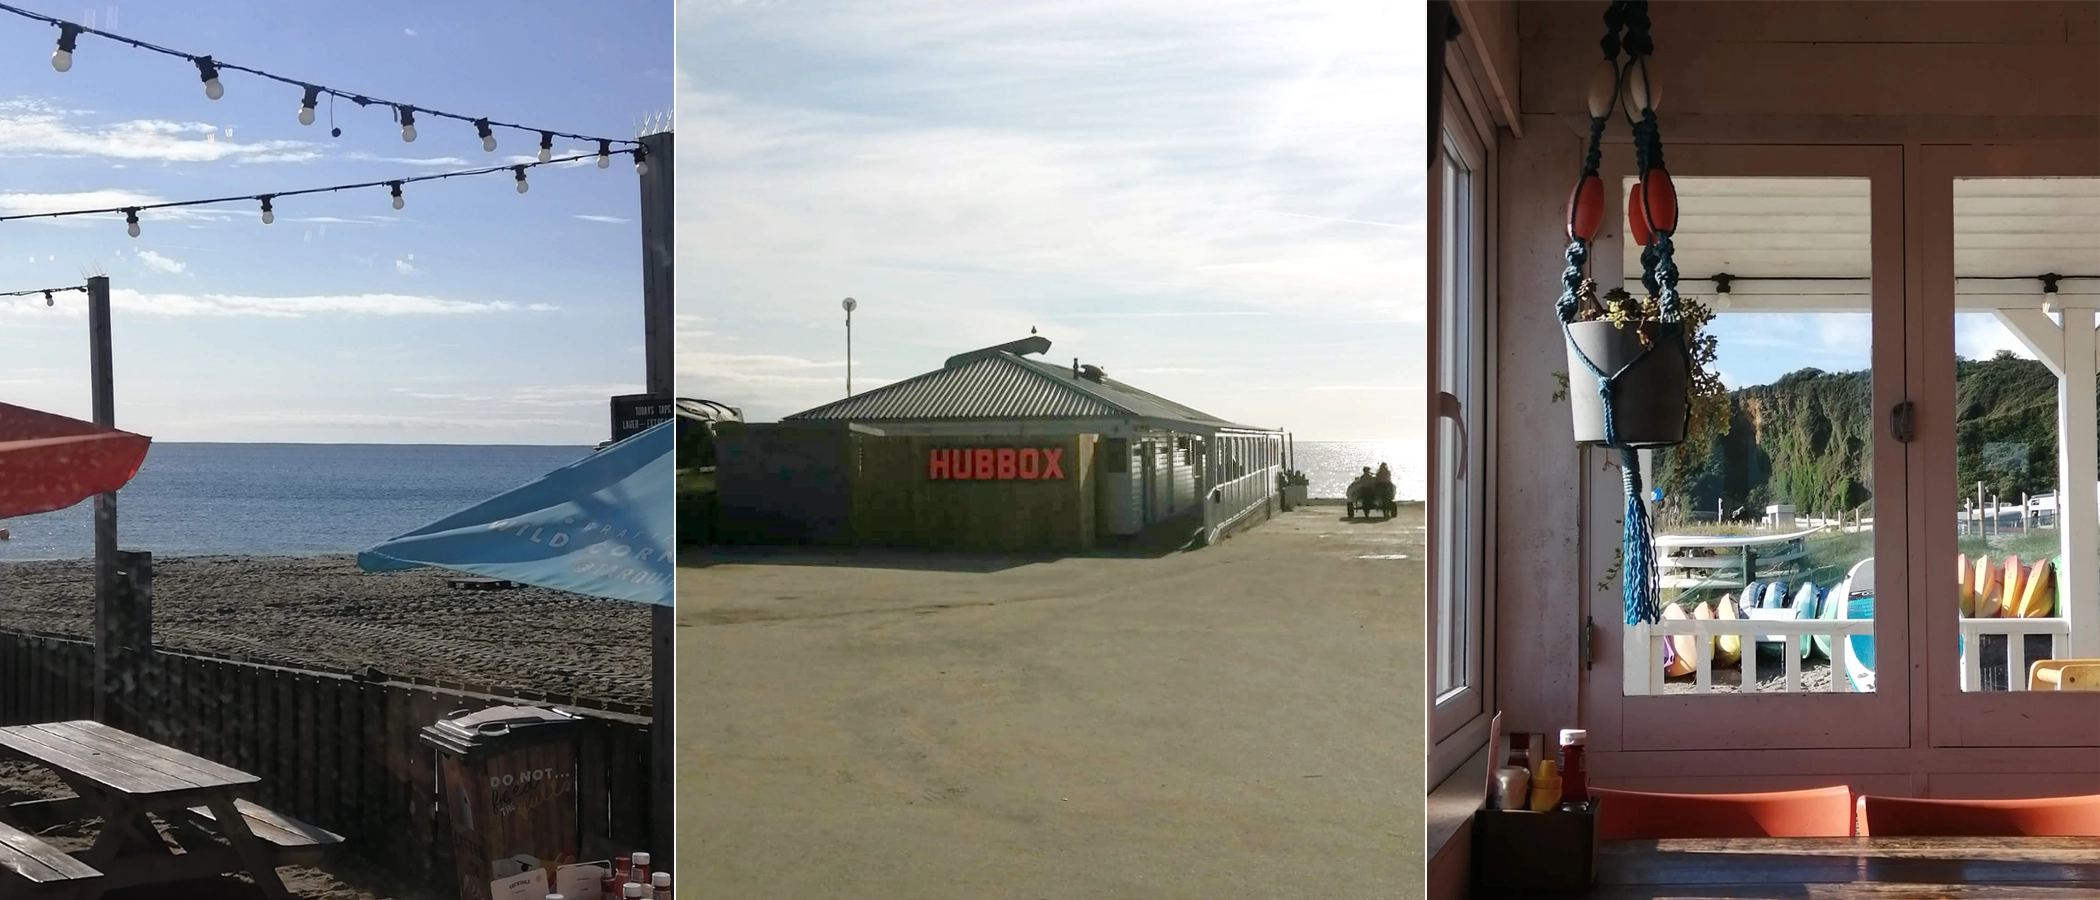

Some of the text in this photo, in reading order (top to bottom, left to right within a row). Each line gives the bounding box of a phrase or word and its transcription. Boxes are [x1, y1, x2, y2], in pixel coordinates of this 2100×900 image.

[929, 448, 1064, 480] HUBBOX
[490, 773, 514, 788] DO
[499, 802, 516, 817] THE
